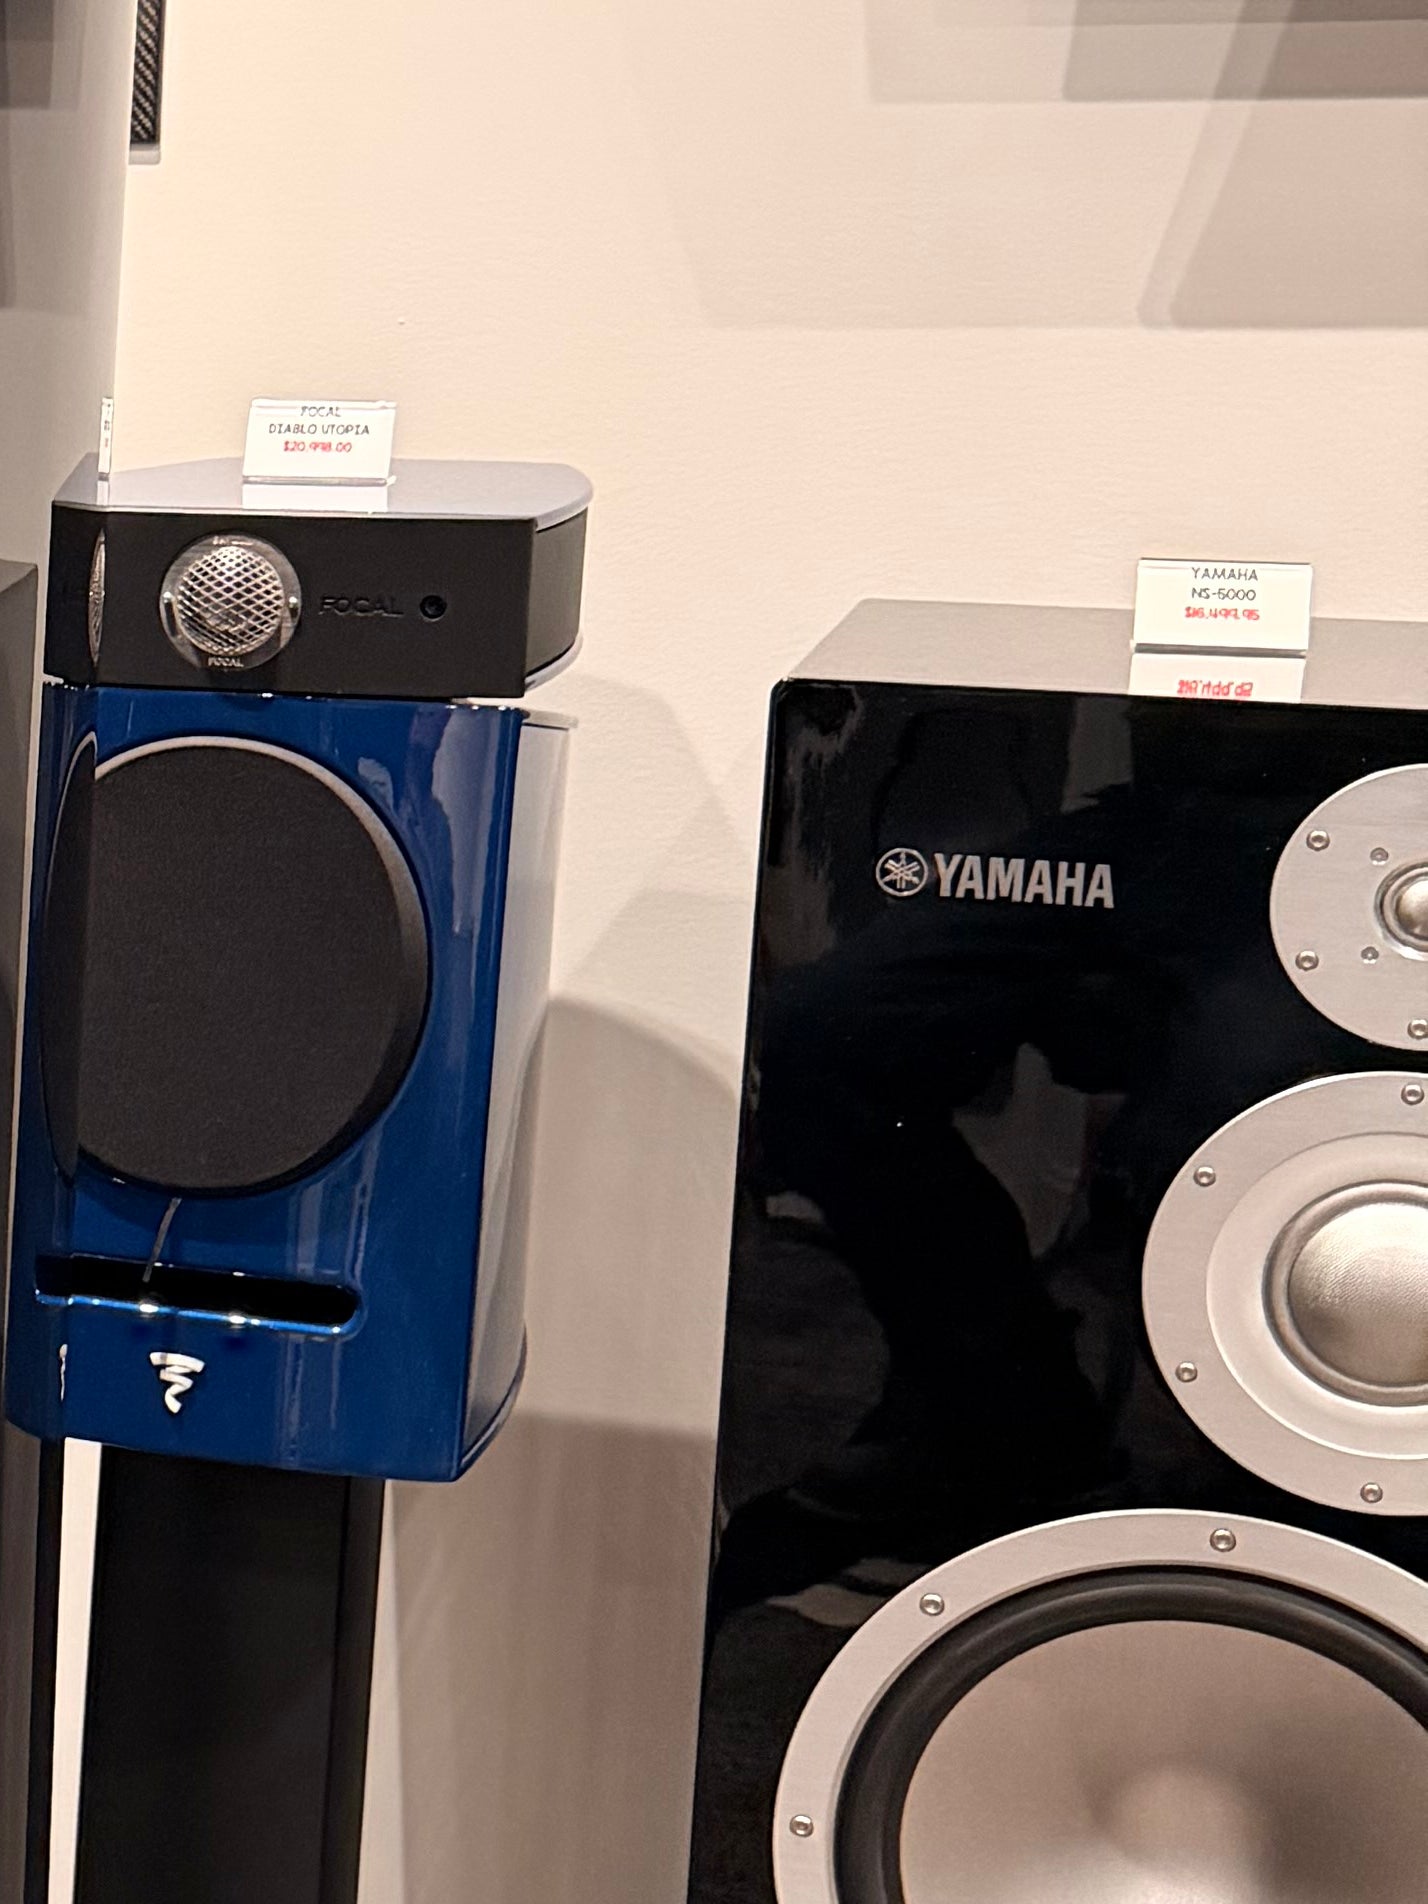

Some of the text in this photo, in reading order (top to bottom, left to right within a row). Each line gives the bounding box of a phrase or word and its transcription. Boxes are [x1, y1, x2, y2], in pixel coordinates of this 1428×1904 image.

[300, 406, 341, 417] FOCAL
[268, 423, 370, 435] DIABLO UTOPIA
[1191, 567, 1259, 581] YAMAHA
[1191, 587, 1257, 601] NS-5000
[934, 852, 1115, 909] YAMAHA
